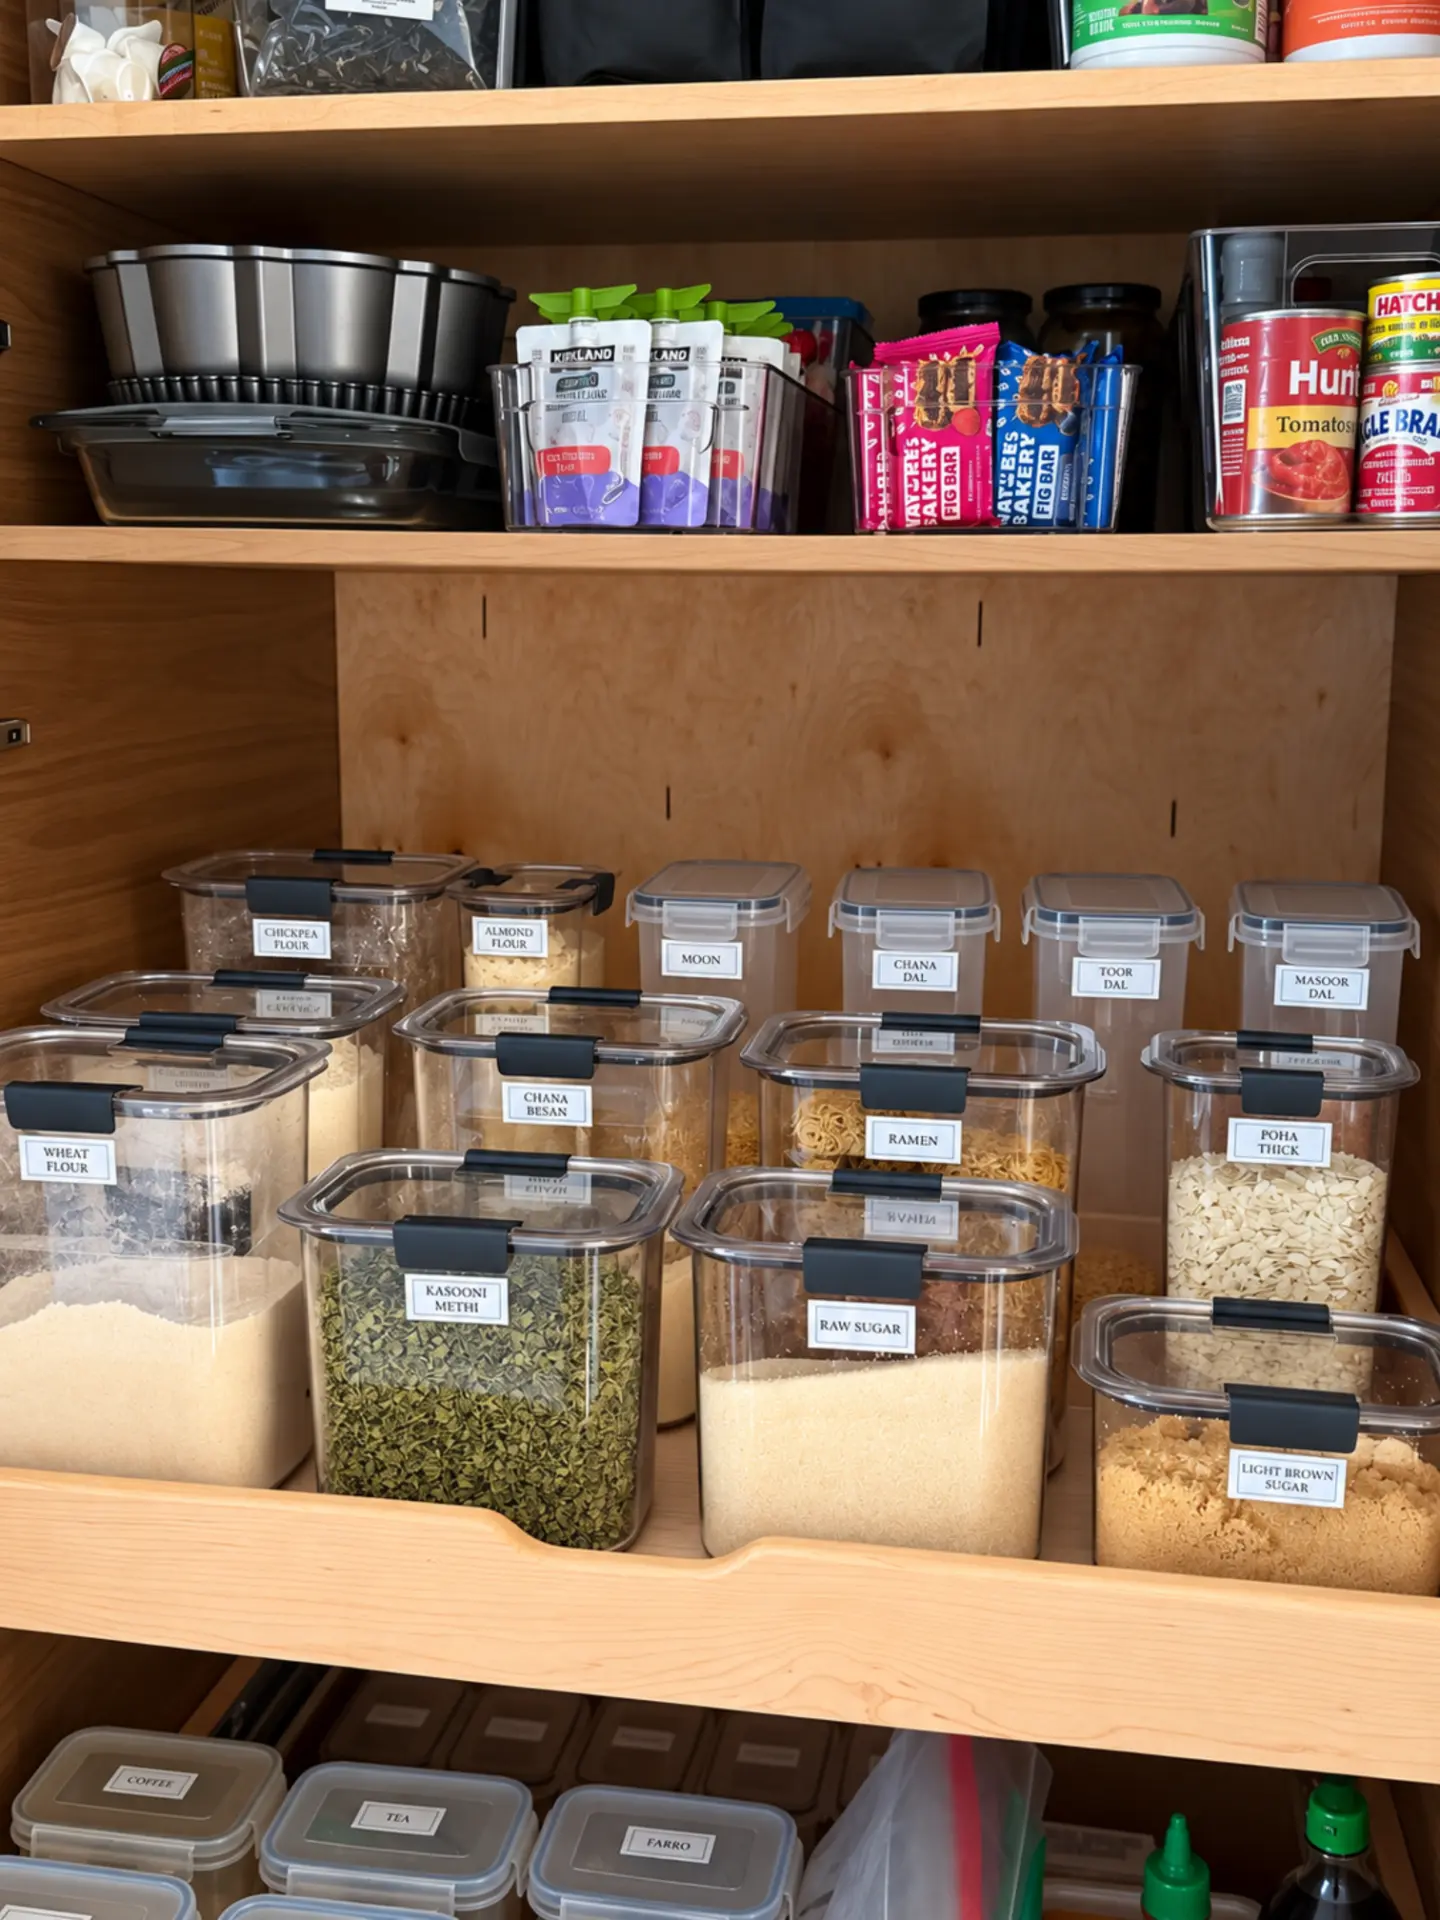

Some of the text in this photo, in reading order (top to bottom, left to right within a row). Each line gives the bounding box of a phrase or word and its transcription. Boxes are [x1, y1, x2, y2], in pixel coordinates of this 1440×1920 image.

[1377, 292, 1440, 316] HATCH
[650, 349, 687, 361] LAND
[1362, 408, 1440, 443] GLE BRA
[944, 451, 957, 518] FIG BAR
[1013, 432, 1035, 525] BAKERY
[1036, 450, 1055, 515] FIG BAR
[265, 927, 318, 940] CHICKPEA
[485, 927, 534, 938] ALMOND
[274, 939, 309, 951] FLOUR
[491, 938, 527, 949] FLOUR
[681, 954, 721, 965] MOON
[894, 959, 937, 970] CHANA
[903, 972, 927, 983] DAL
[1099, 967, 1133, 977] TOOR
[1104, 980, 1128, 990] DAL
[1295, 975, 1349, 987] MASOOR
[1309, 989, 1335, 999] DAL
[524, 1092, 568, 1104] CHANA
[527, 1105, 567, 1117] BESAN
[889, 1134, 938, 1146] RAMEN
[1261, 1130, 1298, 1142] POHA
[44, 1146, 89, 1160] WHEAT
[1258, 1144, 1299, 1155] THICK
[46, 1160, 89, 1173] FLOUR
[426, 1285, 487, 1298] KASOONI
[435, 1302, 479, 1313] METHI
[820, 1319, 901, 1334] RAW SUGAR
[1242, 1463, 1334, 1481] LIGHT BROWN
[1265, 1480, 1309, 1493] SUGAR
[127, 1775, 174, 1789] COFFEE
[385, 1812, 410, 1823] TEA
[646, 1838, 691, 1851] FARRO
